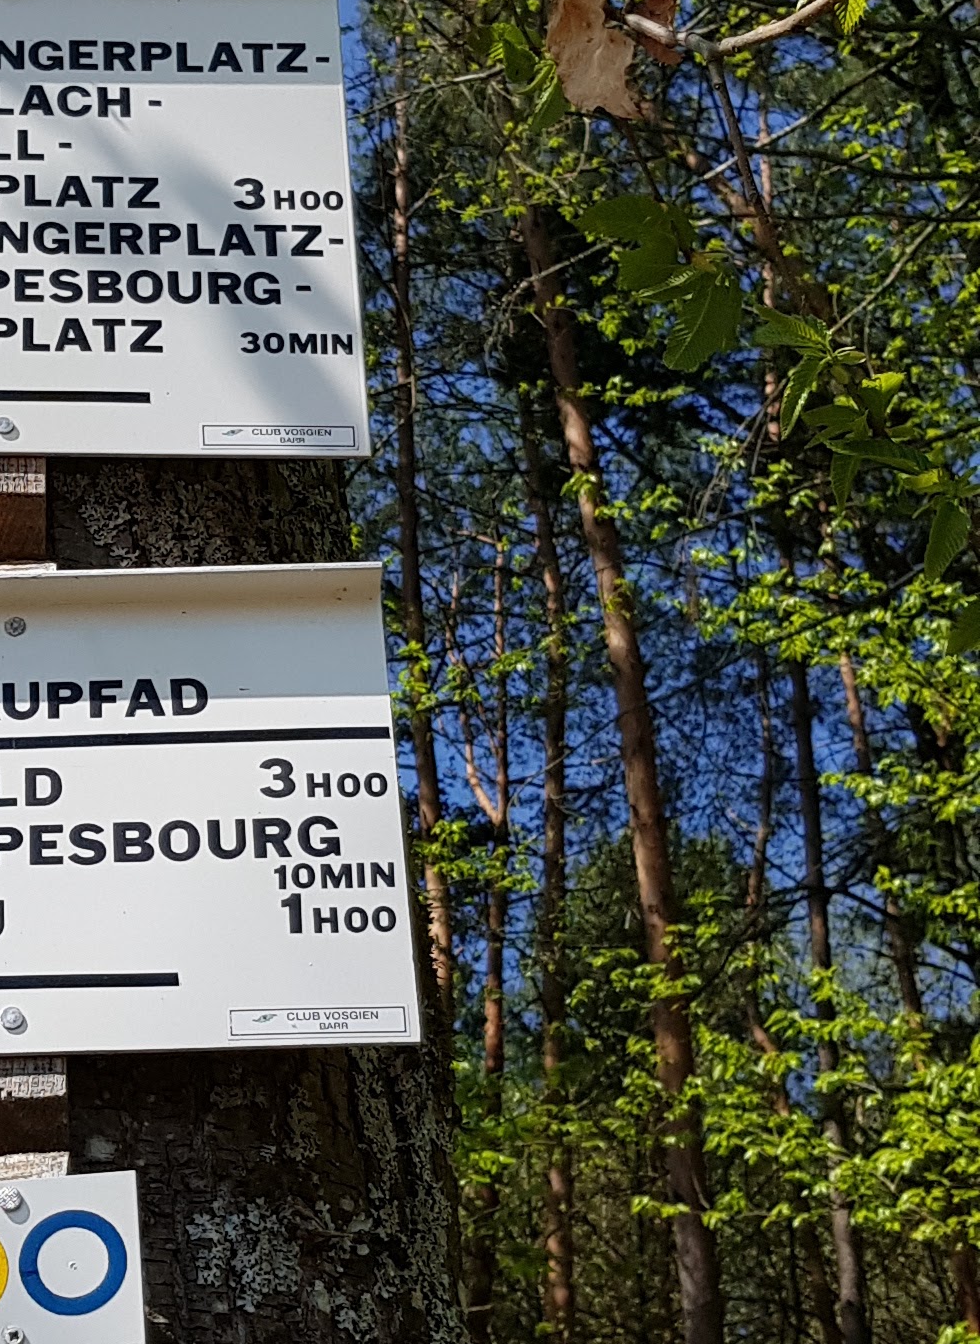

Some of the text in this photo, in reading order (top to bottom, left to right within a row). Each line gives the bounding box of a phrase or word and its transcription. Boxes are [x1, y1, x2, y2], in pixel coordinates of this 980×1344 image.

[240, 331, 354, 355] 30MIN
[251, 428, 332, 437] CLUB VOSGIEN
[274, 862, 396, 890] 10MIN
[286, 1011, 379, 1021] CLUB VOSGIEN
